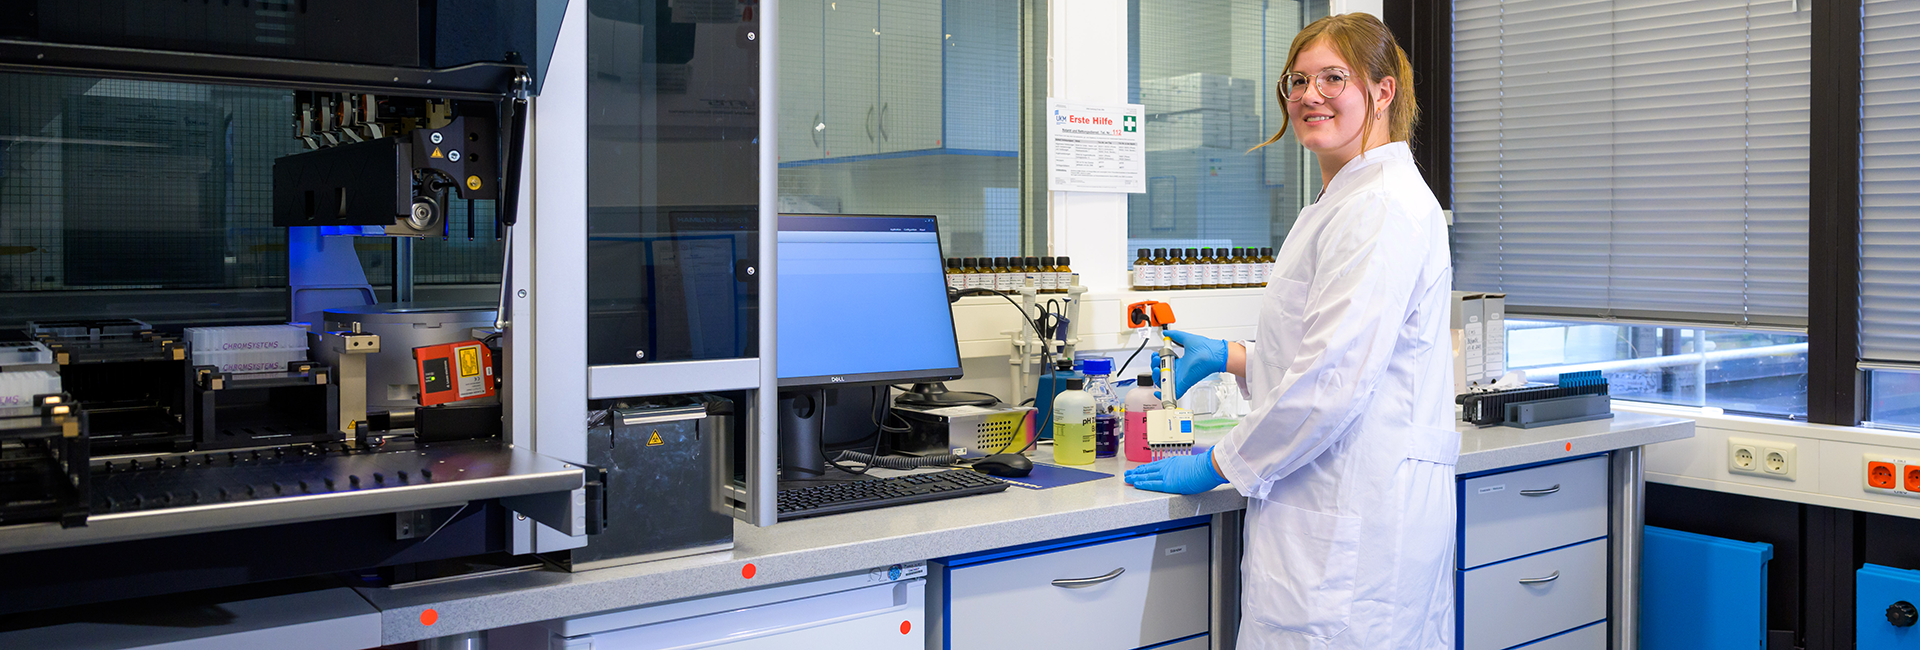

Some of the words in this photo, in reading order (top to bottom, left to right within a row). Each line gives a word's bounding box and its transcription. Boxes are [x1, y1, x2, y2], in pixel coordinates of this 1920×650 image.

[1069, 115, 1090, 125] Erste
[1092, 116, 1113, 126] Hilfe
[222, 341, 279, 350] CHROMSYSTEMS
[222, 362, 279, 372] CHROMSYSTEMS
[1082, 417, 1092, 426] pH
